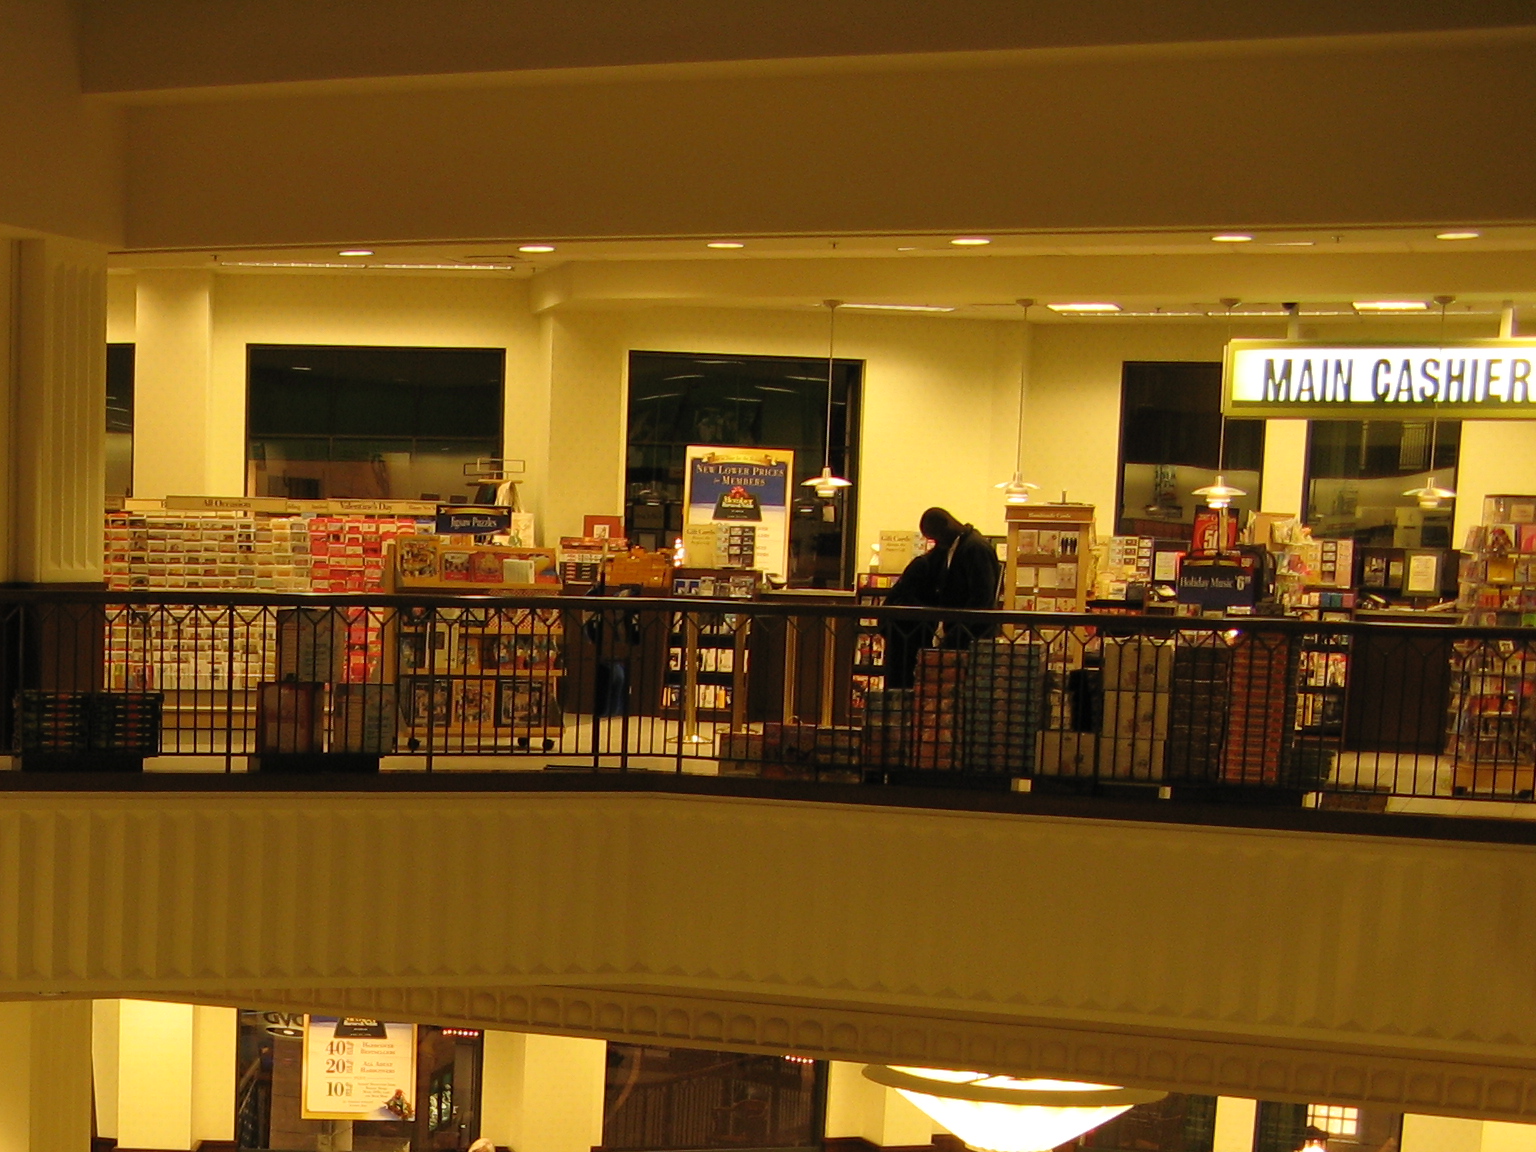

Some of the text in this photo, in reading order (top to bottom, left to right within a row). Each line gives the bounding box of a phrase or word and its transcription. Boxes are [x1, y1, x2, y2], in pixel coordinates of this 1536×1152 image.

[1262, 358, 1531, 402] MAIN CASHIER
[472, 516, 498, 529] Puzzles
[1180, 577, 1209, 590] Holiday
[1211, 577, 1234, 588] Music
